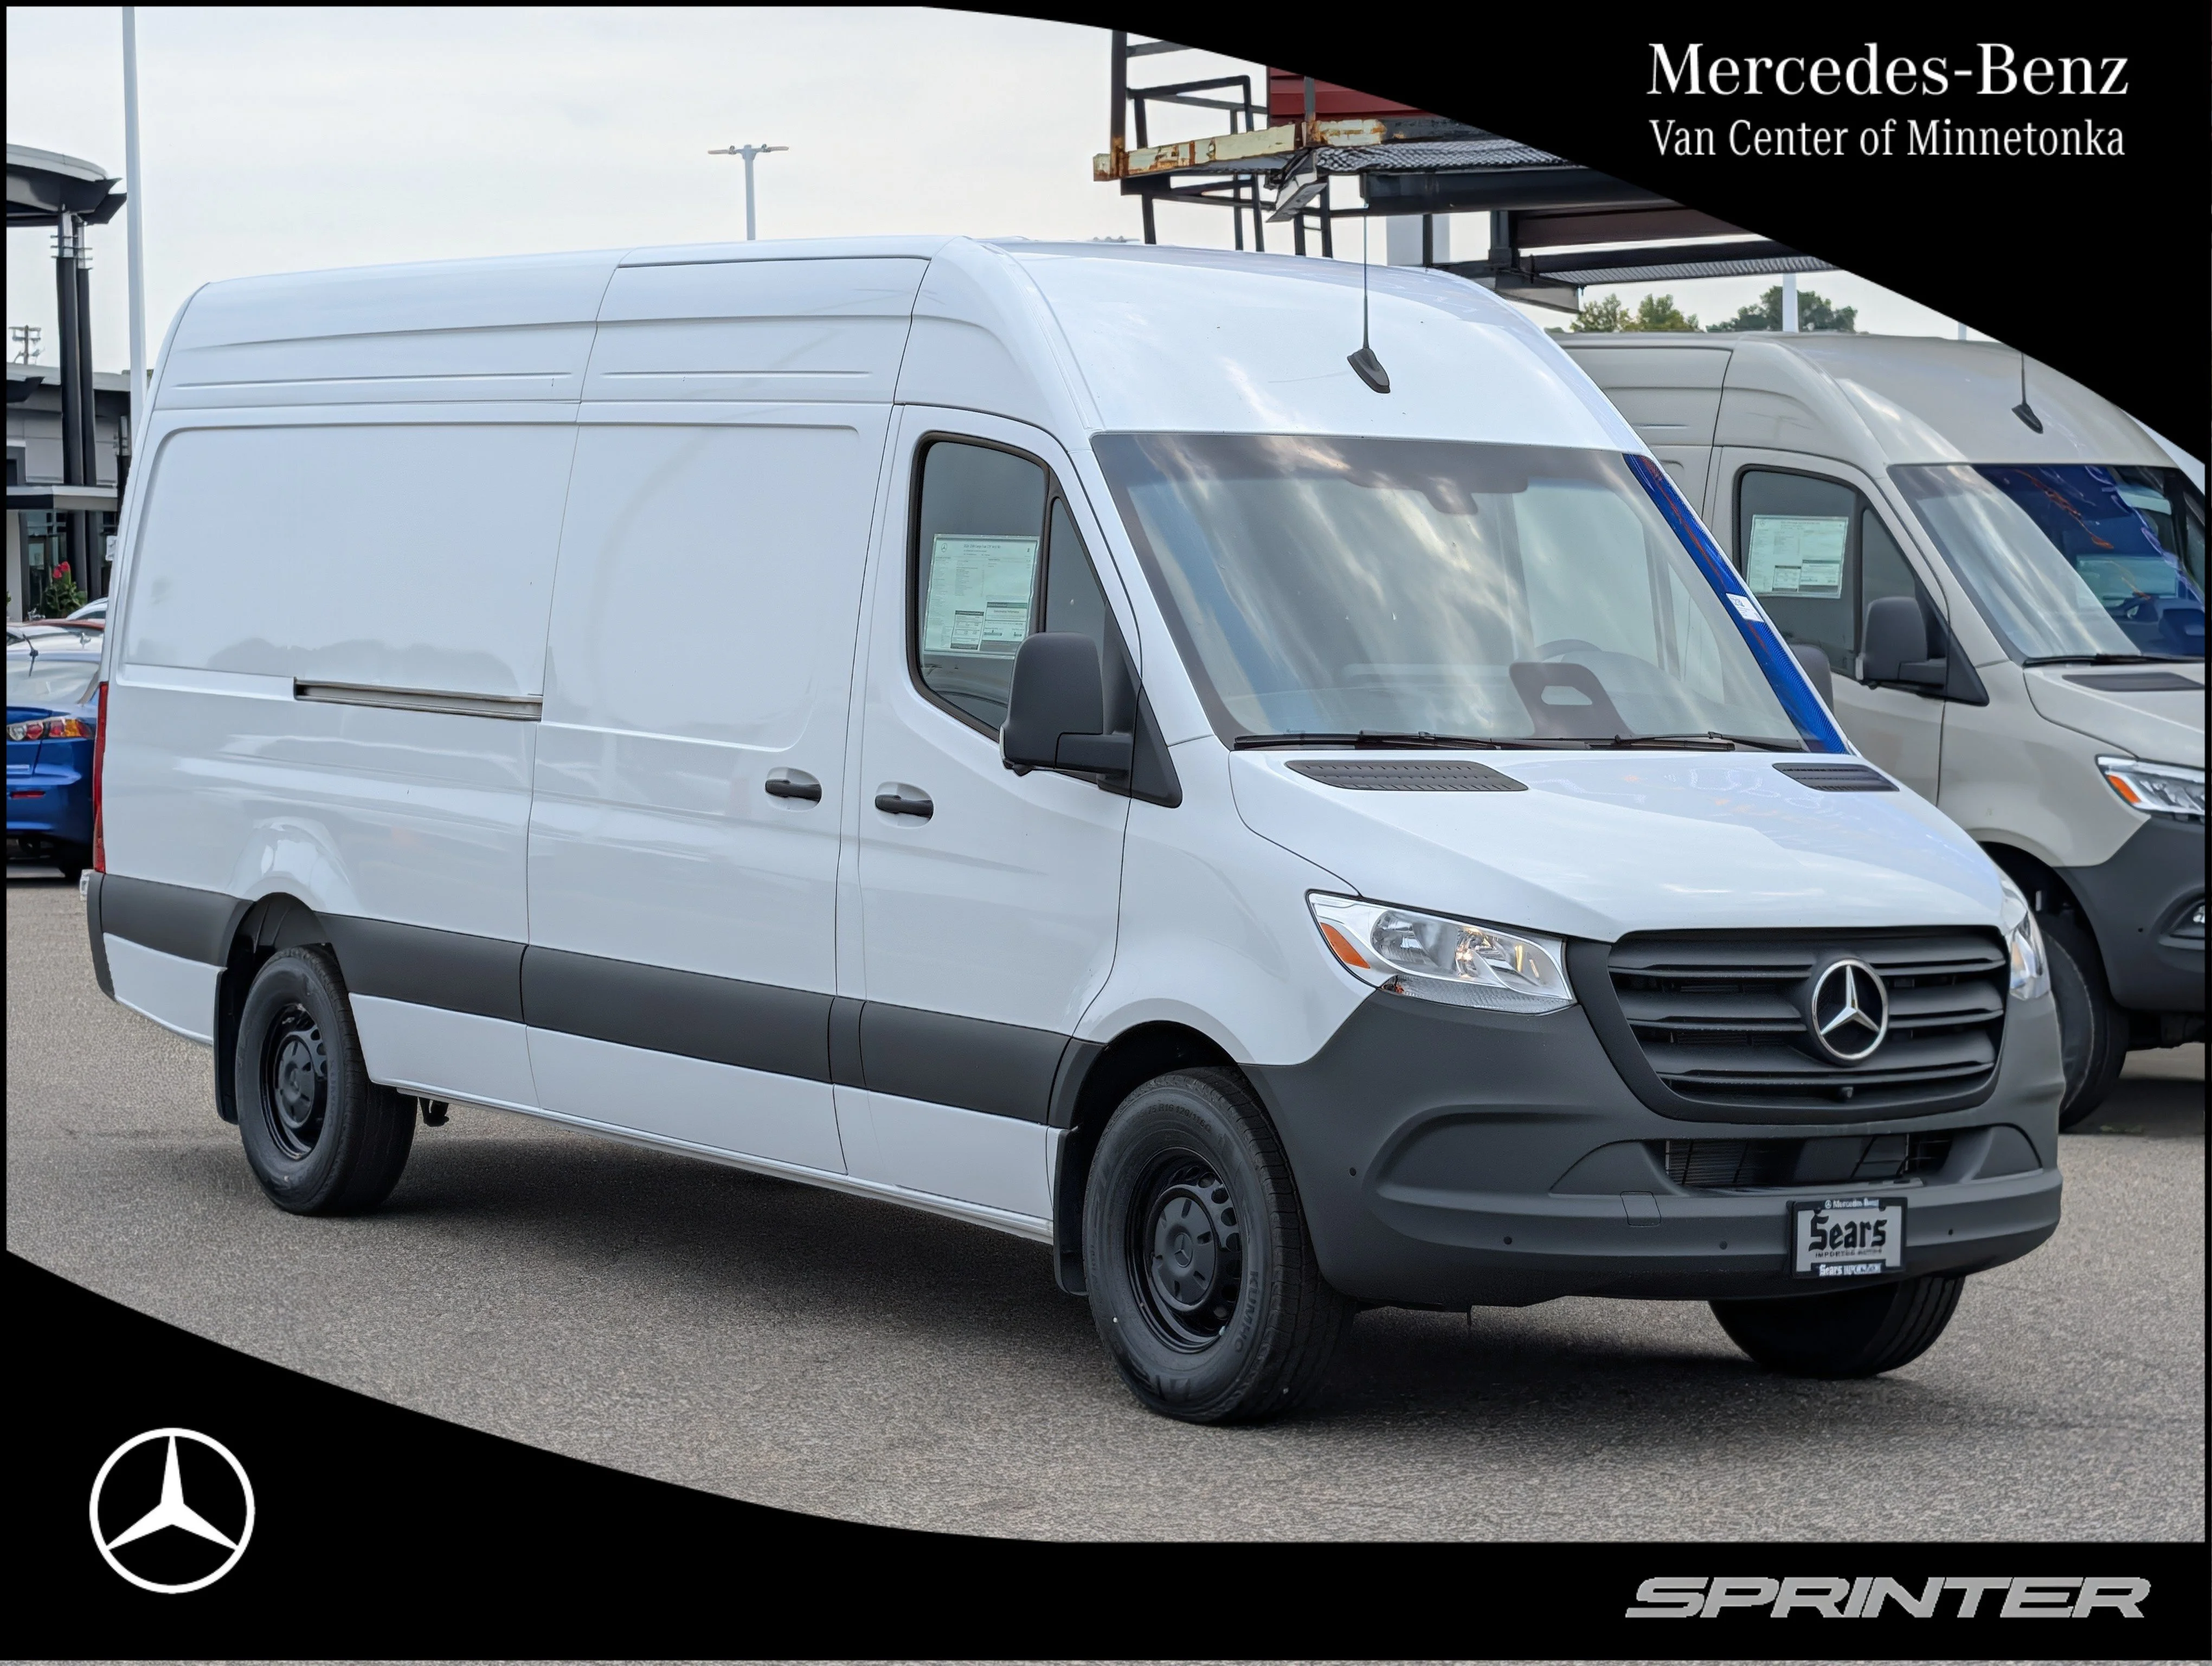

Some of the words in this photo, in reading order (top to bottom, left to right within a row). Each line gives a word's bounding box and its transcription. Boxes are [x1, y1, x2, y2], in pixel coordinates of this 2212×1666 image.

[1809, 1215, 1888, 1252] Sears
[1819, 1264, 1843, 1277] Sears
[1234, 1270, 1259, 1354] KUMHO
